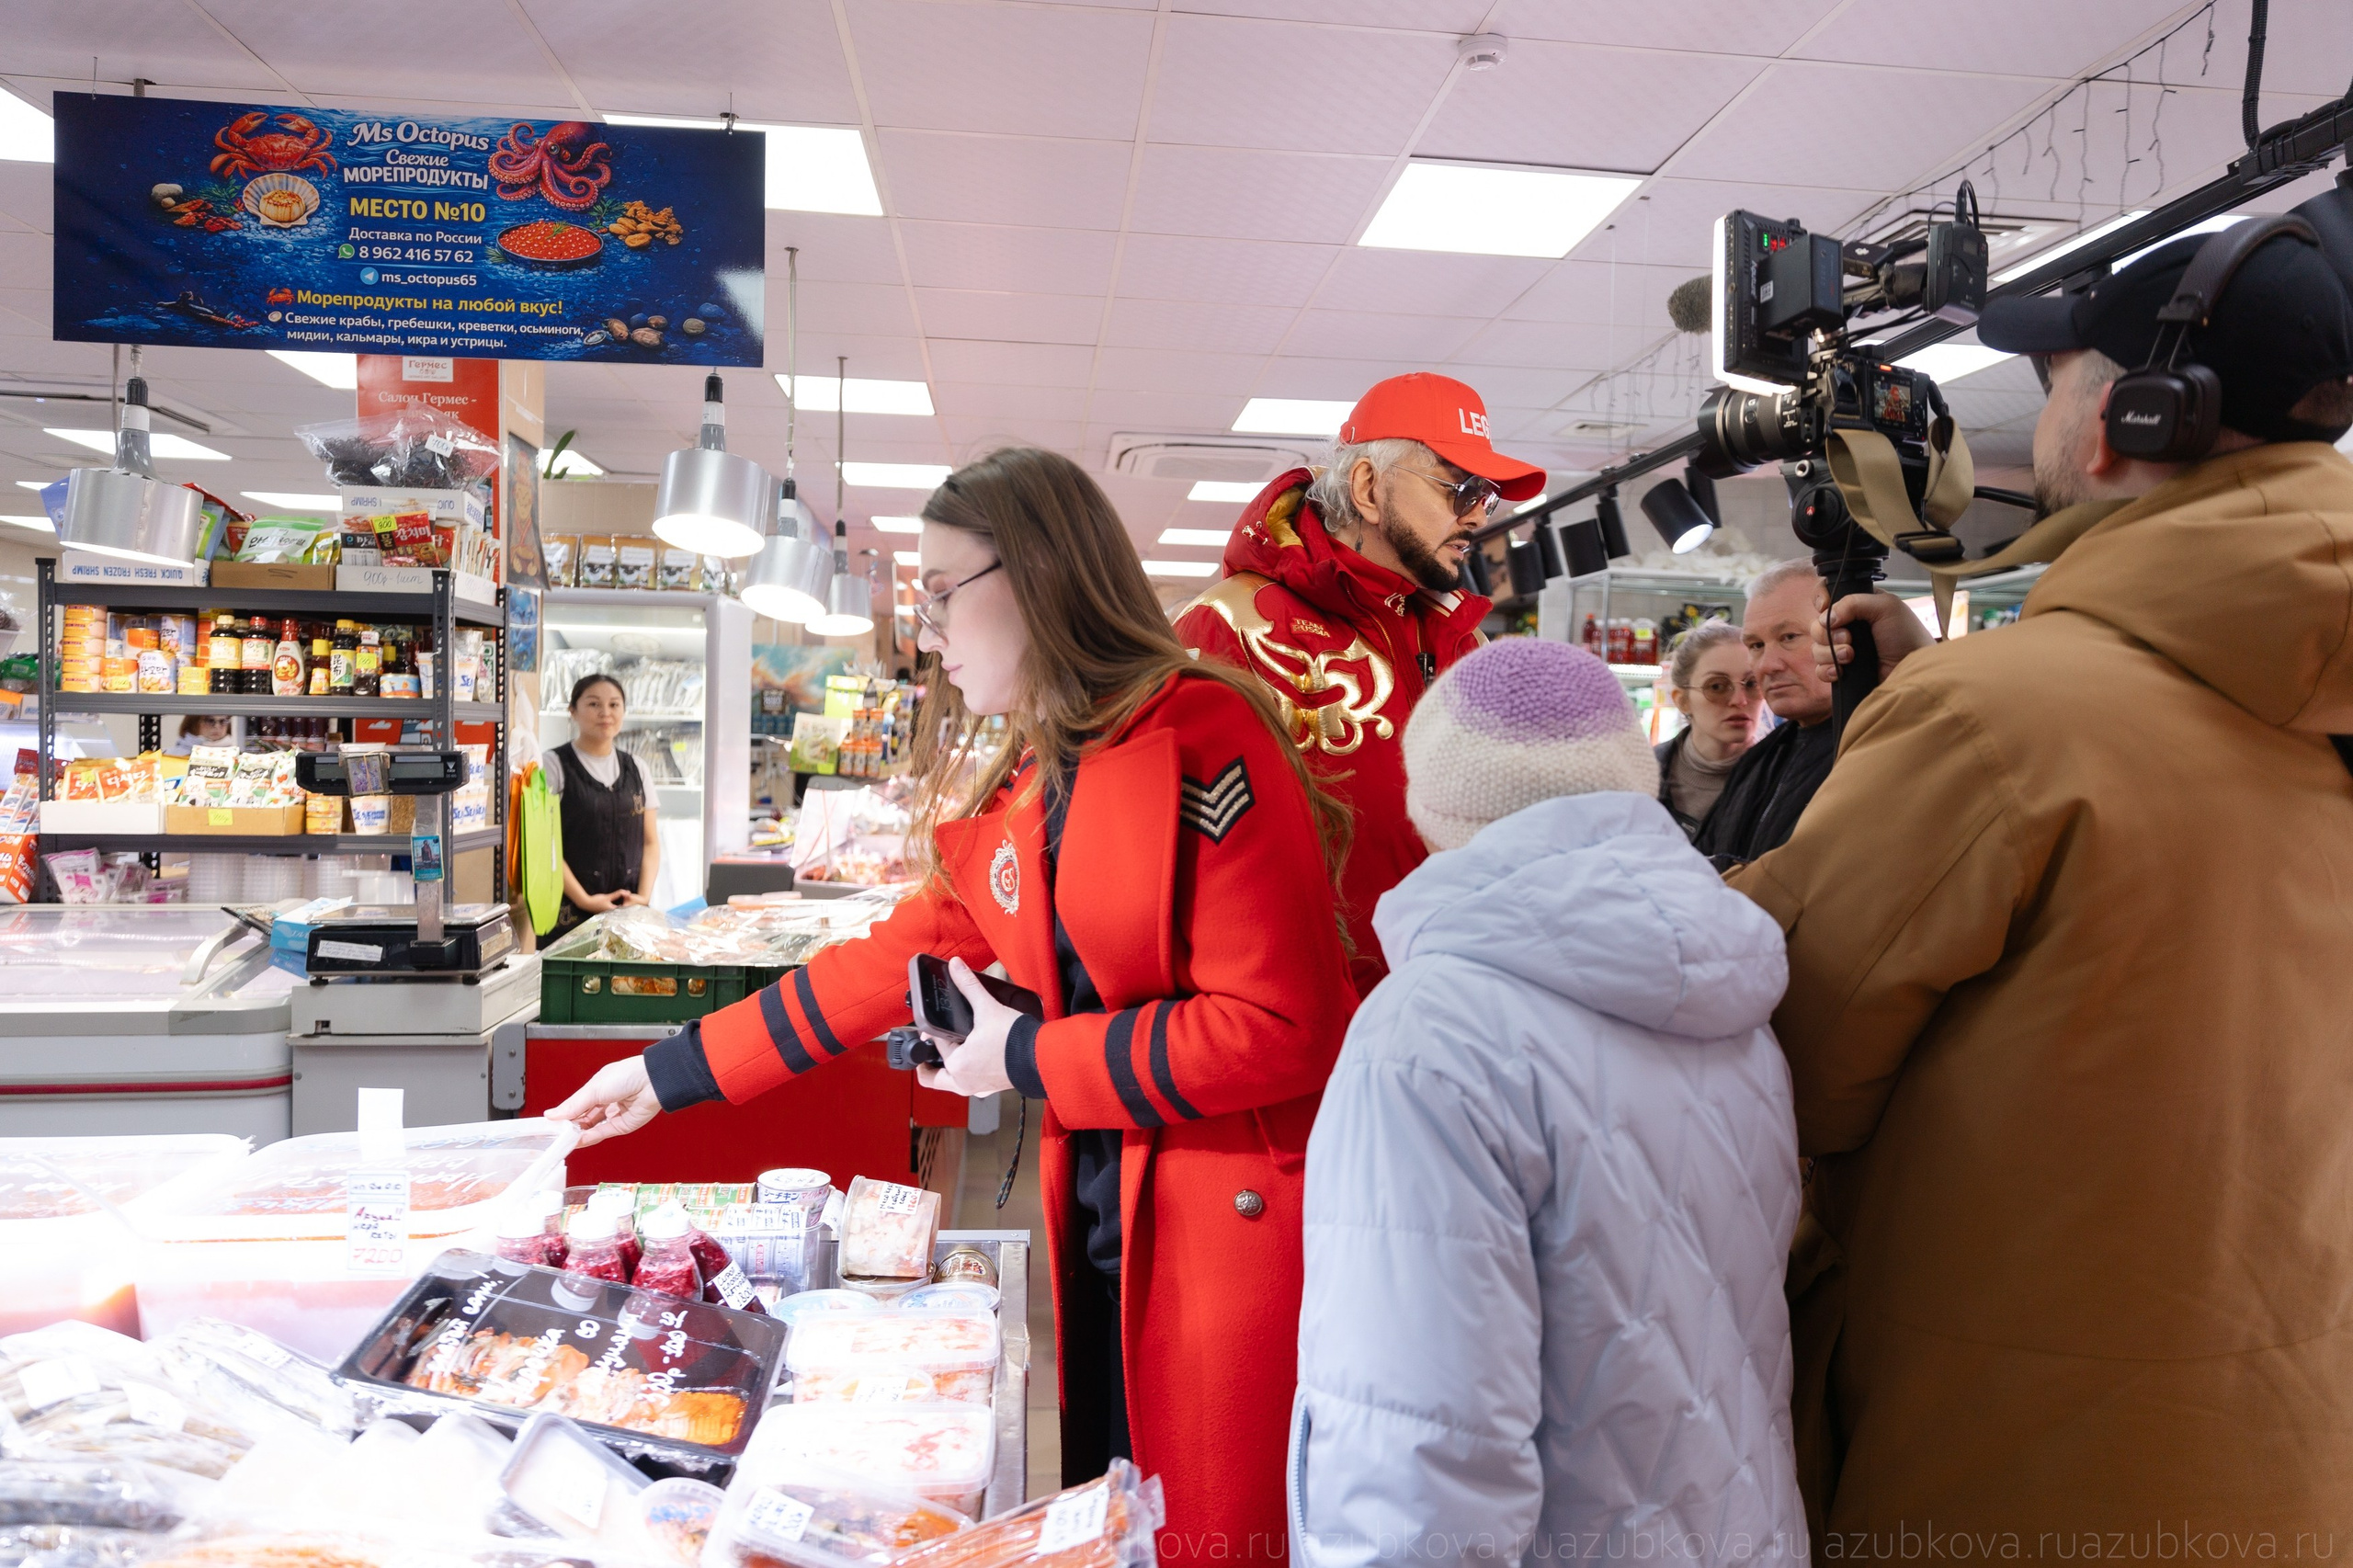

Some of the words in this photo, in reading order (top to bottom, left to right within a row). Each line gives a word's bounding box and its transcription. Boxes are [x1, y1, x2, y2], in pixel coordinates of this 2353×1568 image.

[347, 121, 393, 146] Ms
[396, 120, 490, 151] Octopus
[386, 149, 449, 166] Свежие
[344, 166, 488, 189] МОРЕПРОДУКТЫ
[350, 197, 428, 220] МЕСТО
[434, 201, 486, 222] №10
[348, 227, 413, 242] Доставка
[415, 233, 432, 243] по
[436, 231, 483, 244] России
[358, 246, 369, 259] 8
[372, 246, 402, 260] 962
[404, 248, 431, 262] 416
[434, 249, 451, 262] 57
[454, 250, 473, 264] 62
[381, 273, 477, 288] ms_octopus65
[297, 290, 426, 312] Морепродукты
[432, 299, 453, 311] на
[458, 298, 516, 312] любой
[520, 301, 563, 316] вкус!
[285, 312, 336, 325] Свежие
[339, 314, 385, 329] крабы,
[388, 318, 456, 332] гребешки,
[459, 322, 517, 335] креветки,
[520, 324, 584, 337] осьминоги,
[287, 330, 333, 343] мидии,
[336, 332, 405, 346] кальмары,
[407, 335, 438, 347] икра
[440, 336, 449, 346] и
[450, 335, 507, 349] устрицы.
[408, 359, 448, 369] Гермес
[422, 392, 469, 406] Гермес
[2120, 410, 2162, 426] Marshall
[73, 564, 100, 576] SHRIMP
[104, 566, 131, 578] FROZEN
[134, 568, 157, 579] FRESH
[161, 569, 184, 580] QUICK
[1293, 618, 1324, 631] TEAM
